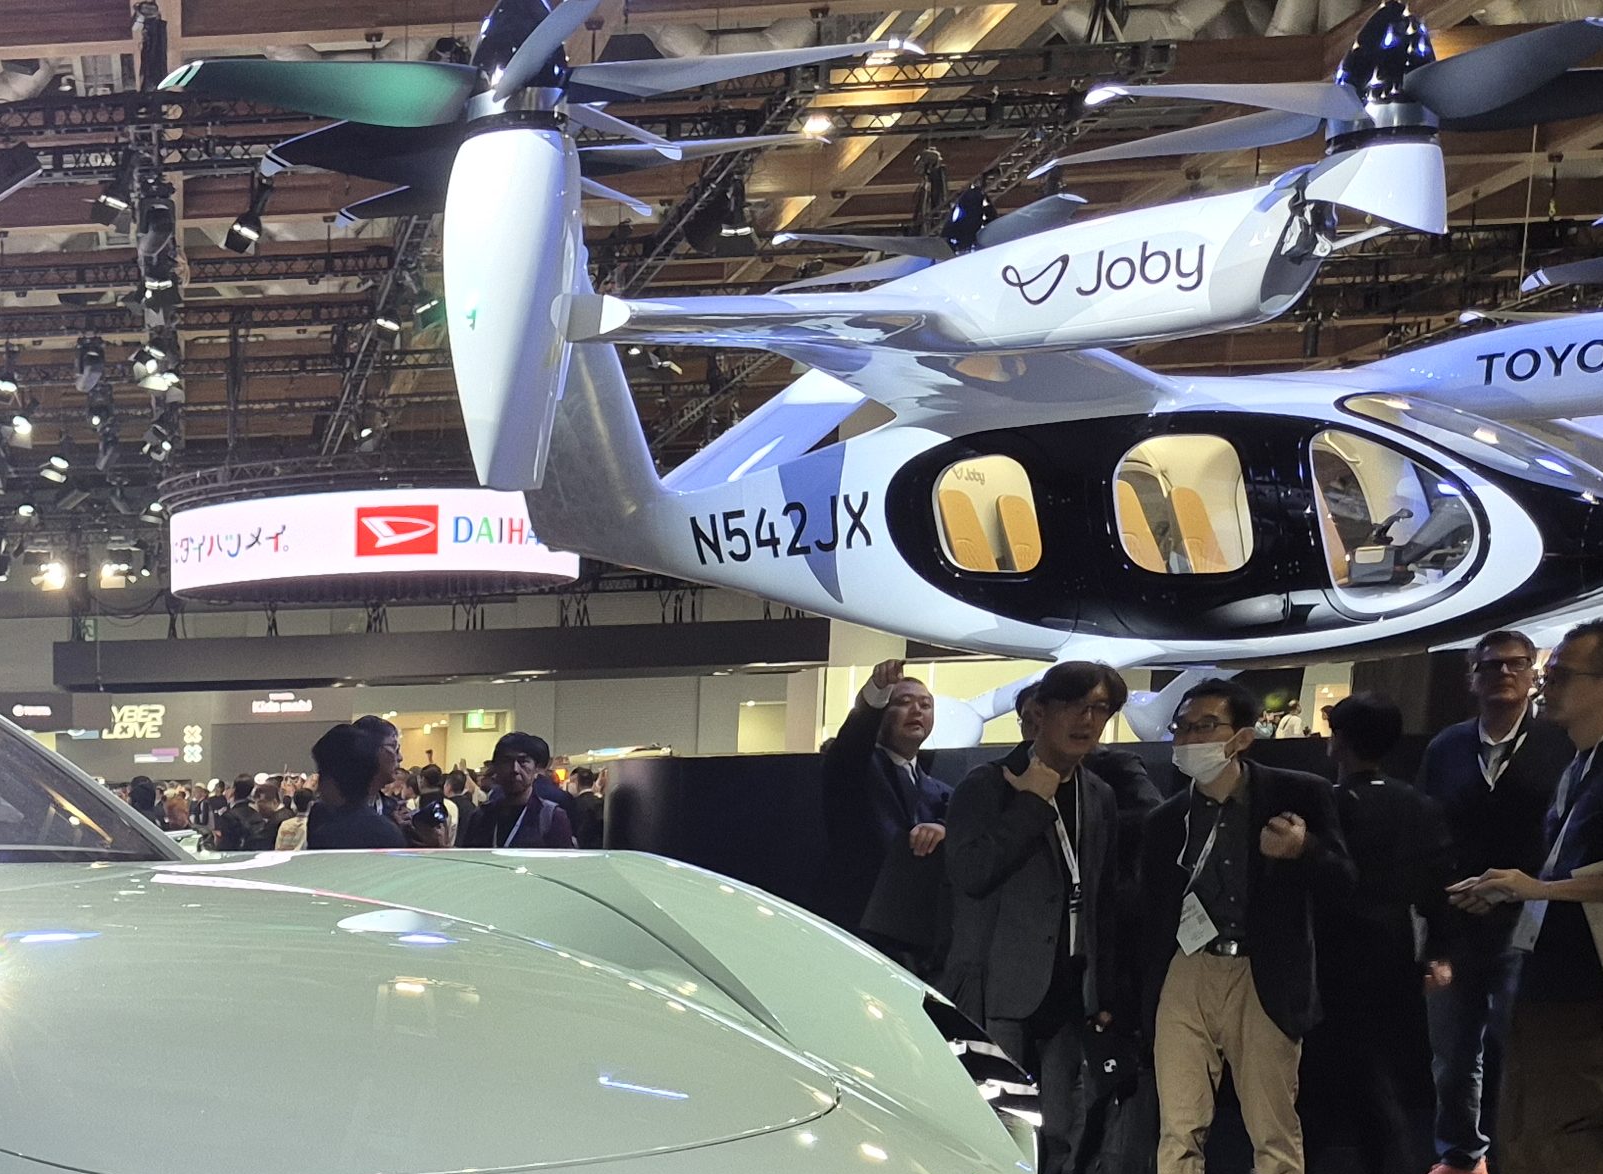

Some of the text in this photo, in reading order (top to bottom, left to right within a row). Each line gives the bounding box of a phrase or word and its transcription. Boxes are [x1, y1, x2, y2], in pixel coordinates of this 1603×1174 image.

[1076, 240, 1205, 297] Joby
[689, 491, 872, 566] N542JX
[110, 704, 165, 726] YBER
